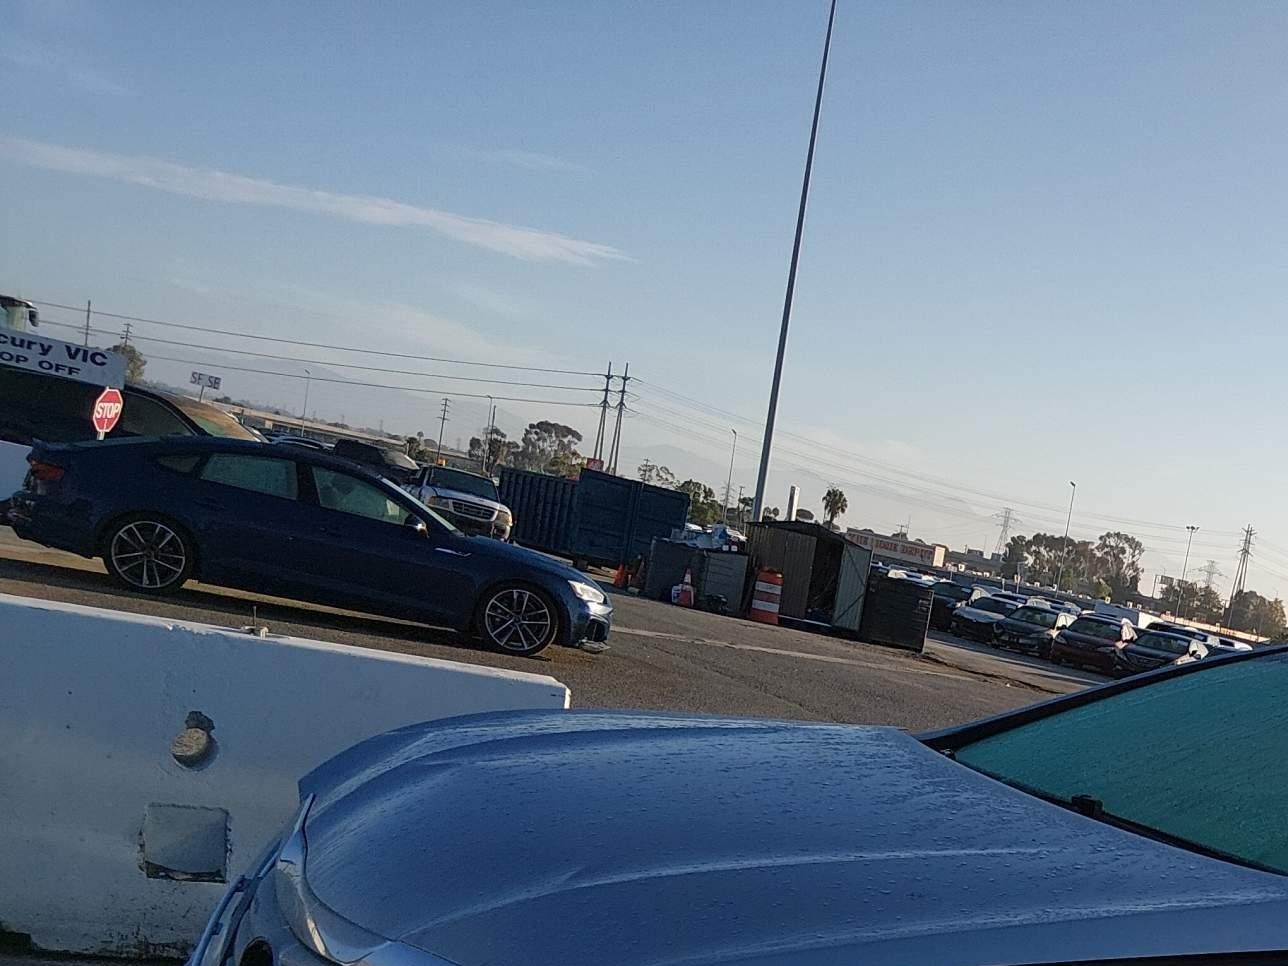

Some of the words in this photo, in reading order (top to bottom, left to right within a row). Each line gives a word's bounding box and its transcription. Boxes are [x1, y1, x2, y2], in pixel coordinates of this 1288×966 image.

[0, 333, 53, 356] cury
[65, 345, 108, 366] VIC
[38, 360, 81, 376] OFF
[95, 402, 121, 419] STOP
